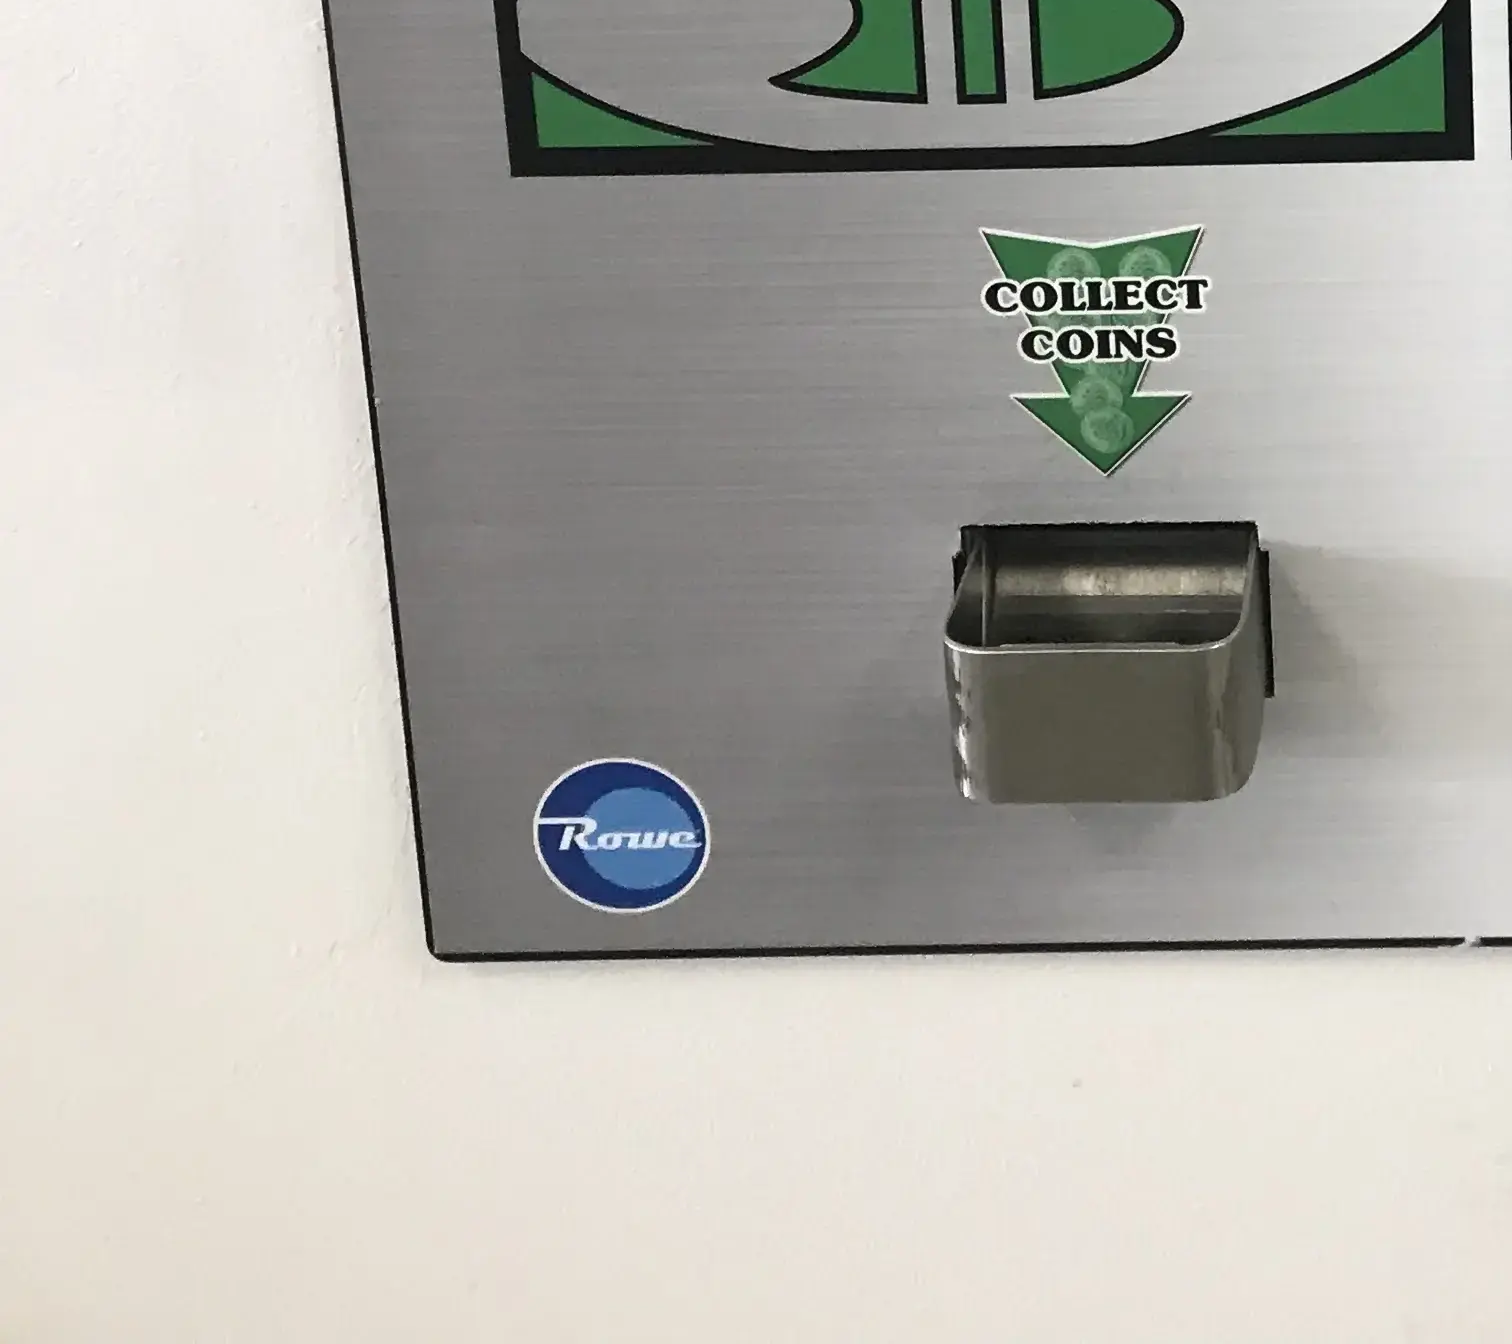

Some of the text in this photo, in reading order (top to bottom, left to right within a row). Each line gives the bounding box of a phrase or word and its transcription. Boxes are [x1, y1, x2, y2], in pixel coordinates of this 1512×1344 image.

[984, 278, 1209, 313] COLLECT
[1020, 326, 1178, 361] COINS
[542, 816, 702, 851] Rowe
